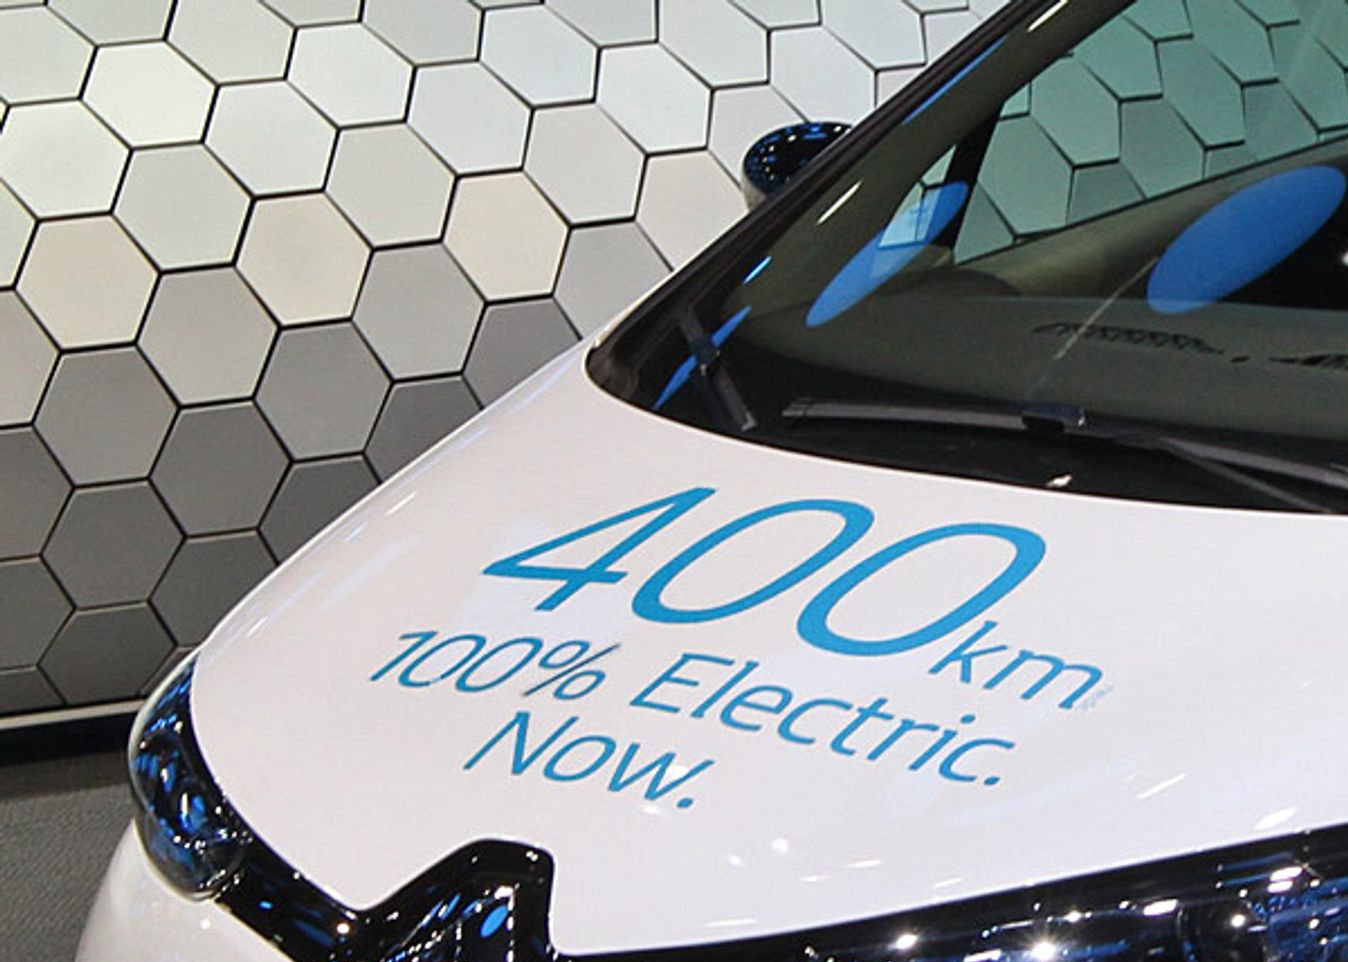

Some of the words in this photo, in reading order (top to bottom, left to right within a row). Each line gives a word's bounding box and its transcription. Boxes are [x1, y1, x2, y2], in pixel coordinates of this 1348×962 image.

[482, 486, 1047, 657] 400
[928, 620, 1103, 710] km
[369, 630, 623, 701] 100%
[628, 651, 1016, 787] Electric.
[462, 710, 715, 810] Now.
